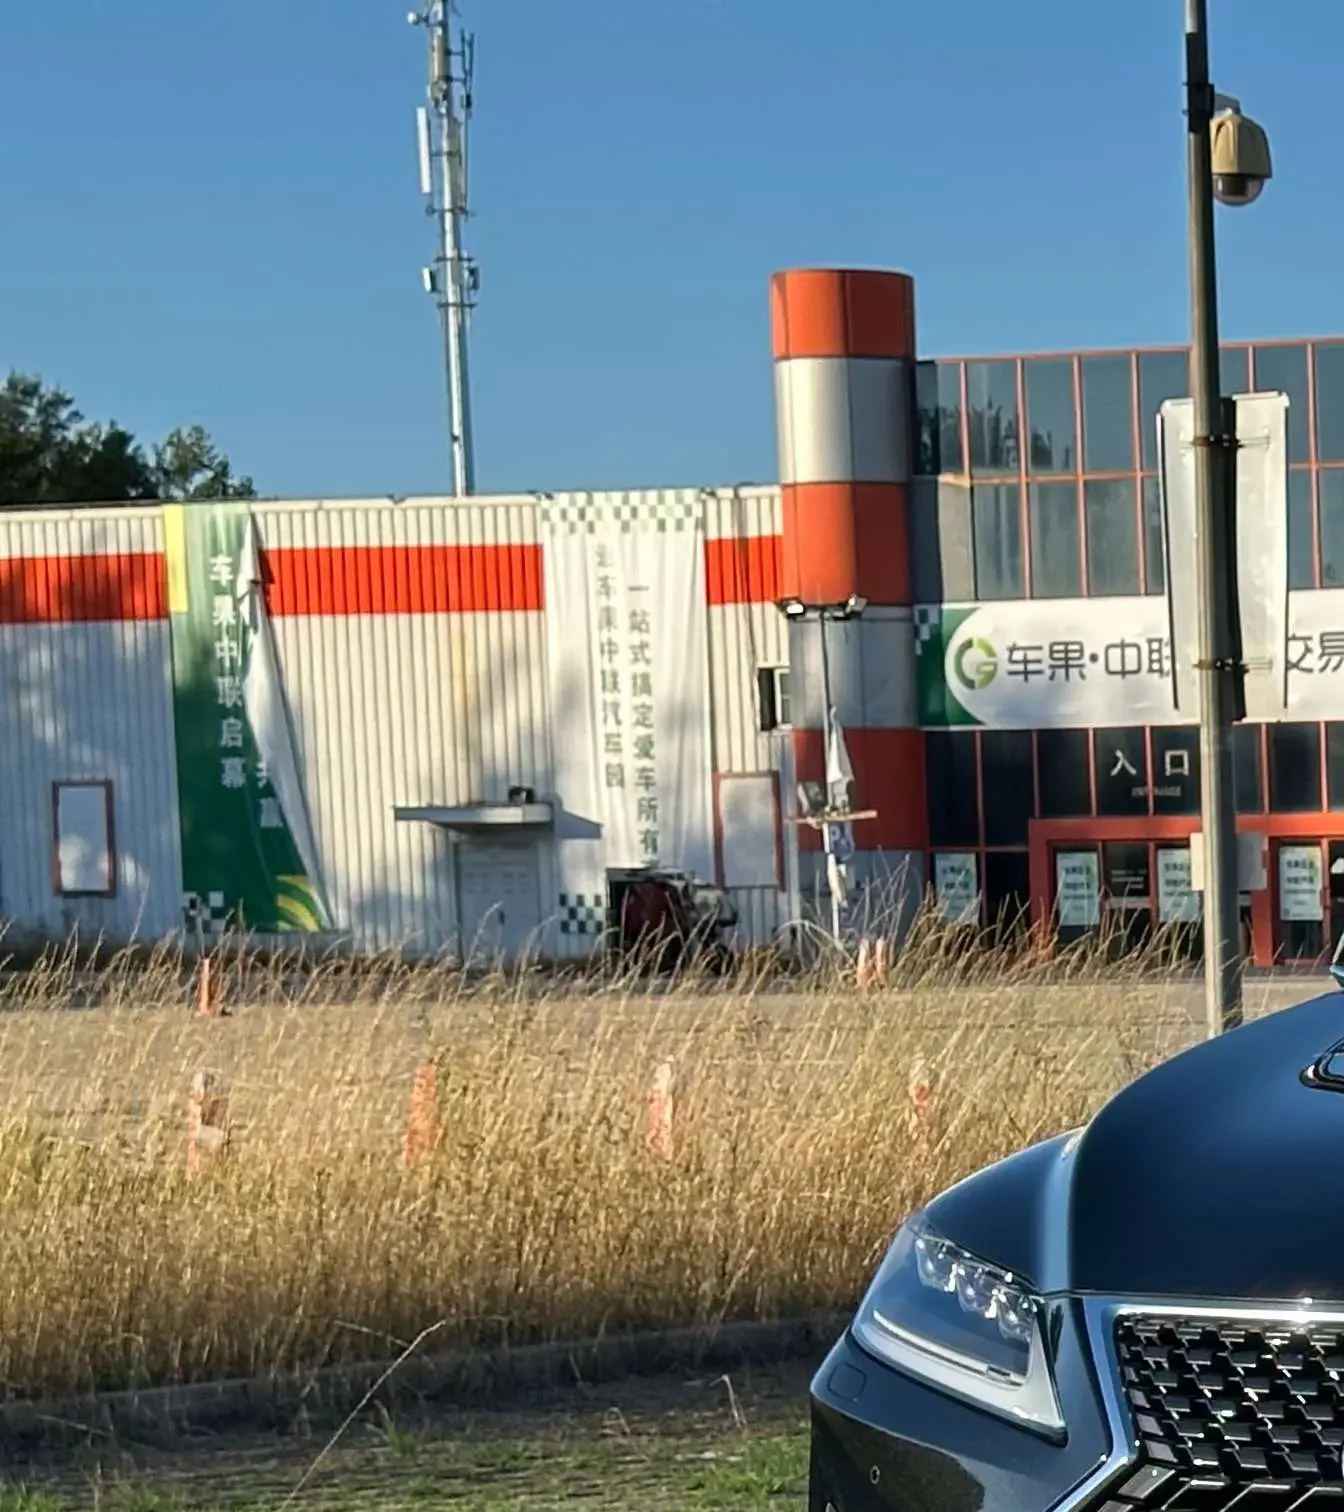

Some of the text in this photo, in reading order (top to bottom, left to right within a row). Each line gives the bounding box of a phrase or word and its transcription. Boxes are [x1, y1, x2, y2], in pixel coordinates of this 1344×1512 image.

[627, 584, 661, 867] 一站式搞定爱车所有
[1110, 749, 1189, 776] 入口
